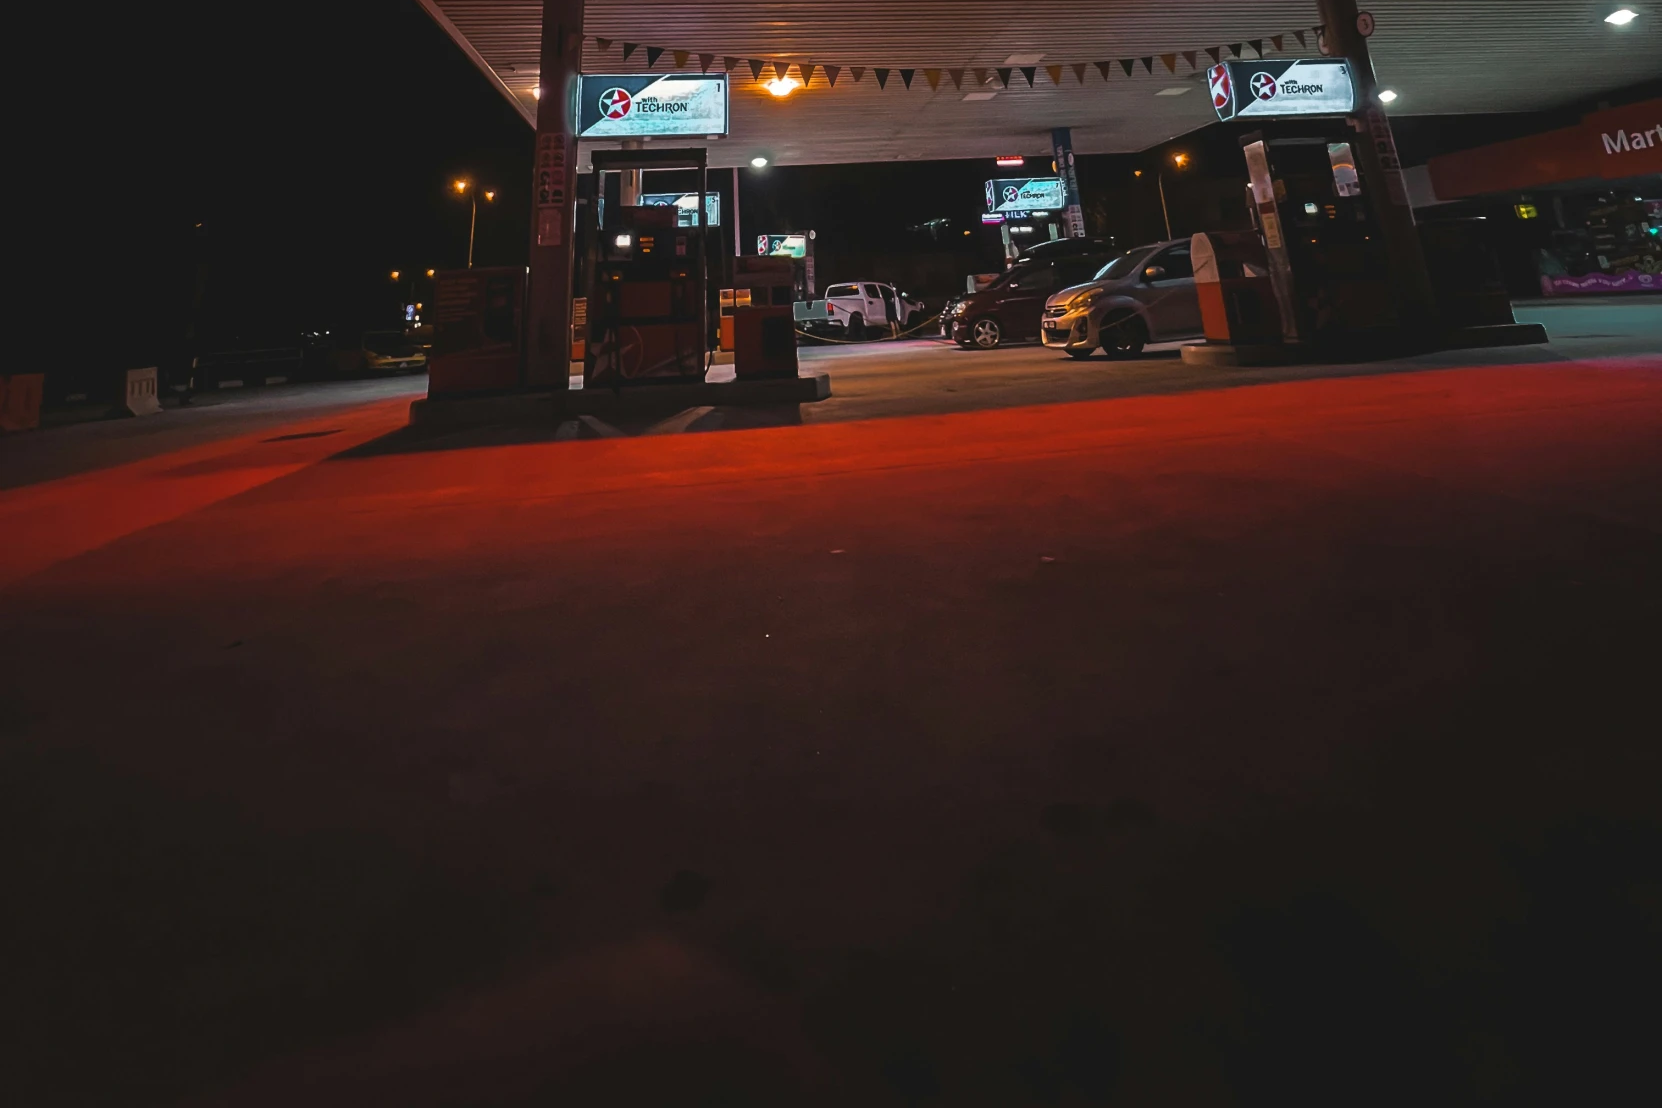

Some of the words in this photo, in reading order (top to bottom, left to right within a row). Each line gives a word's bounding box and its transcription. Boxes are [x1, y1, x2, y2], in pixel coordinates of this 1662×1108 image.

[1340, 65, 1347, 75] 3
[716, 83, 721, 93] 1
[1279, 84, 1323, 96] TECHRON
[635, 101, 688, 114] TECHRON
[1601, 123, 1662, 155] Mart
